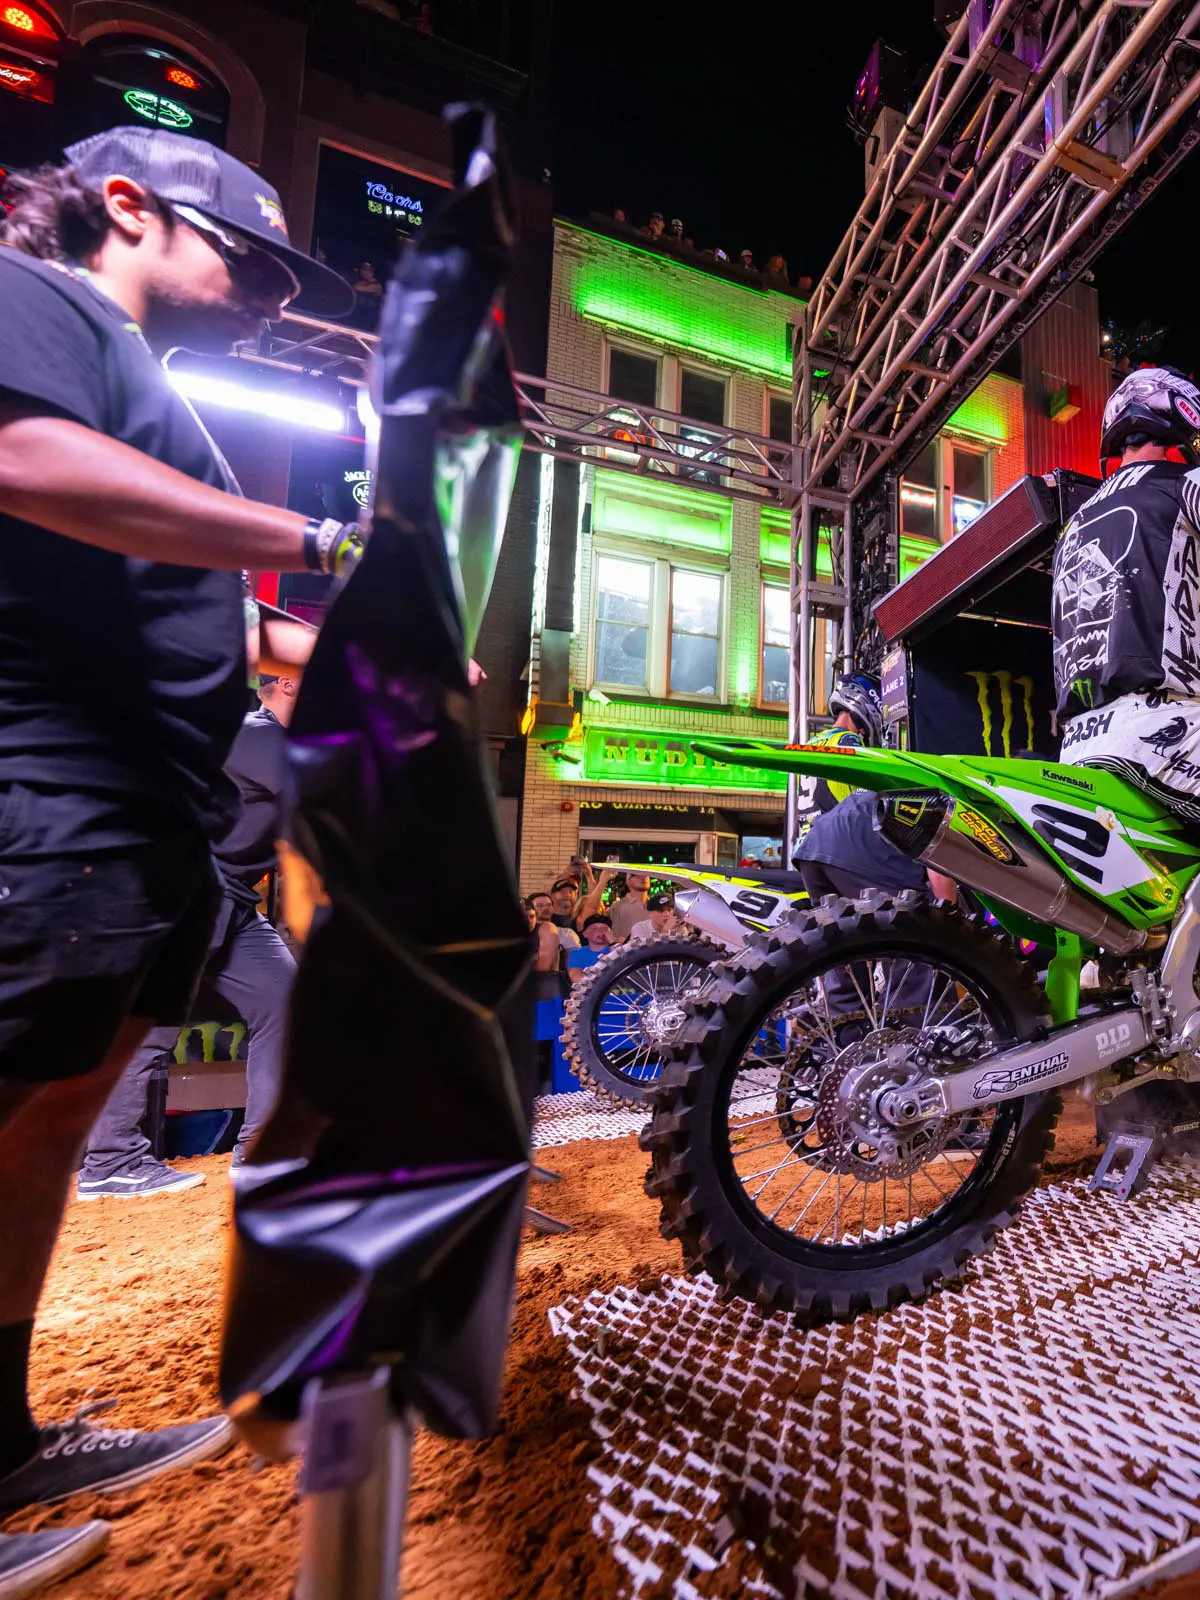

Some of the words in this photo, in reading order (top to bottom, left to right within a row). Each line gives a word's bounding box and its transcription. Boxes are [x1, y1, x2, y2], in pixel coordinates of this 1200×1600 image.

[366, 181, 424, 213] Coors
[1178, 400, 1198, 425] BELL
[881, 678, 899, 697] LANE
[899, 675, 904, 687] 2
[1062, 710, 1115, 749] CASH
[784, 742, 857, 756] MAXXIS
[1042, 767, 1094, 793] Kawasaki
[958, 812, 1009, 860] CIRCUIT
[1030, 803, 1110, 885] 2
[729, 889, 780, 920] 9
[1018, 1063, 1068, 1086] CHAINWHEELS
